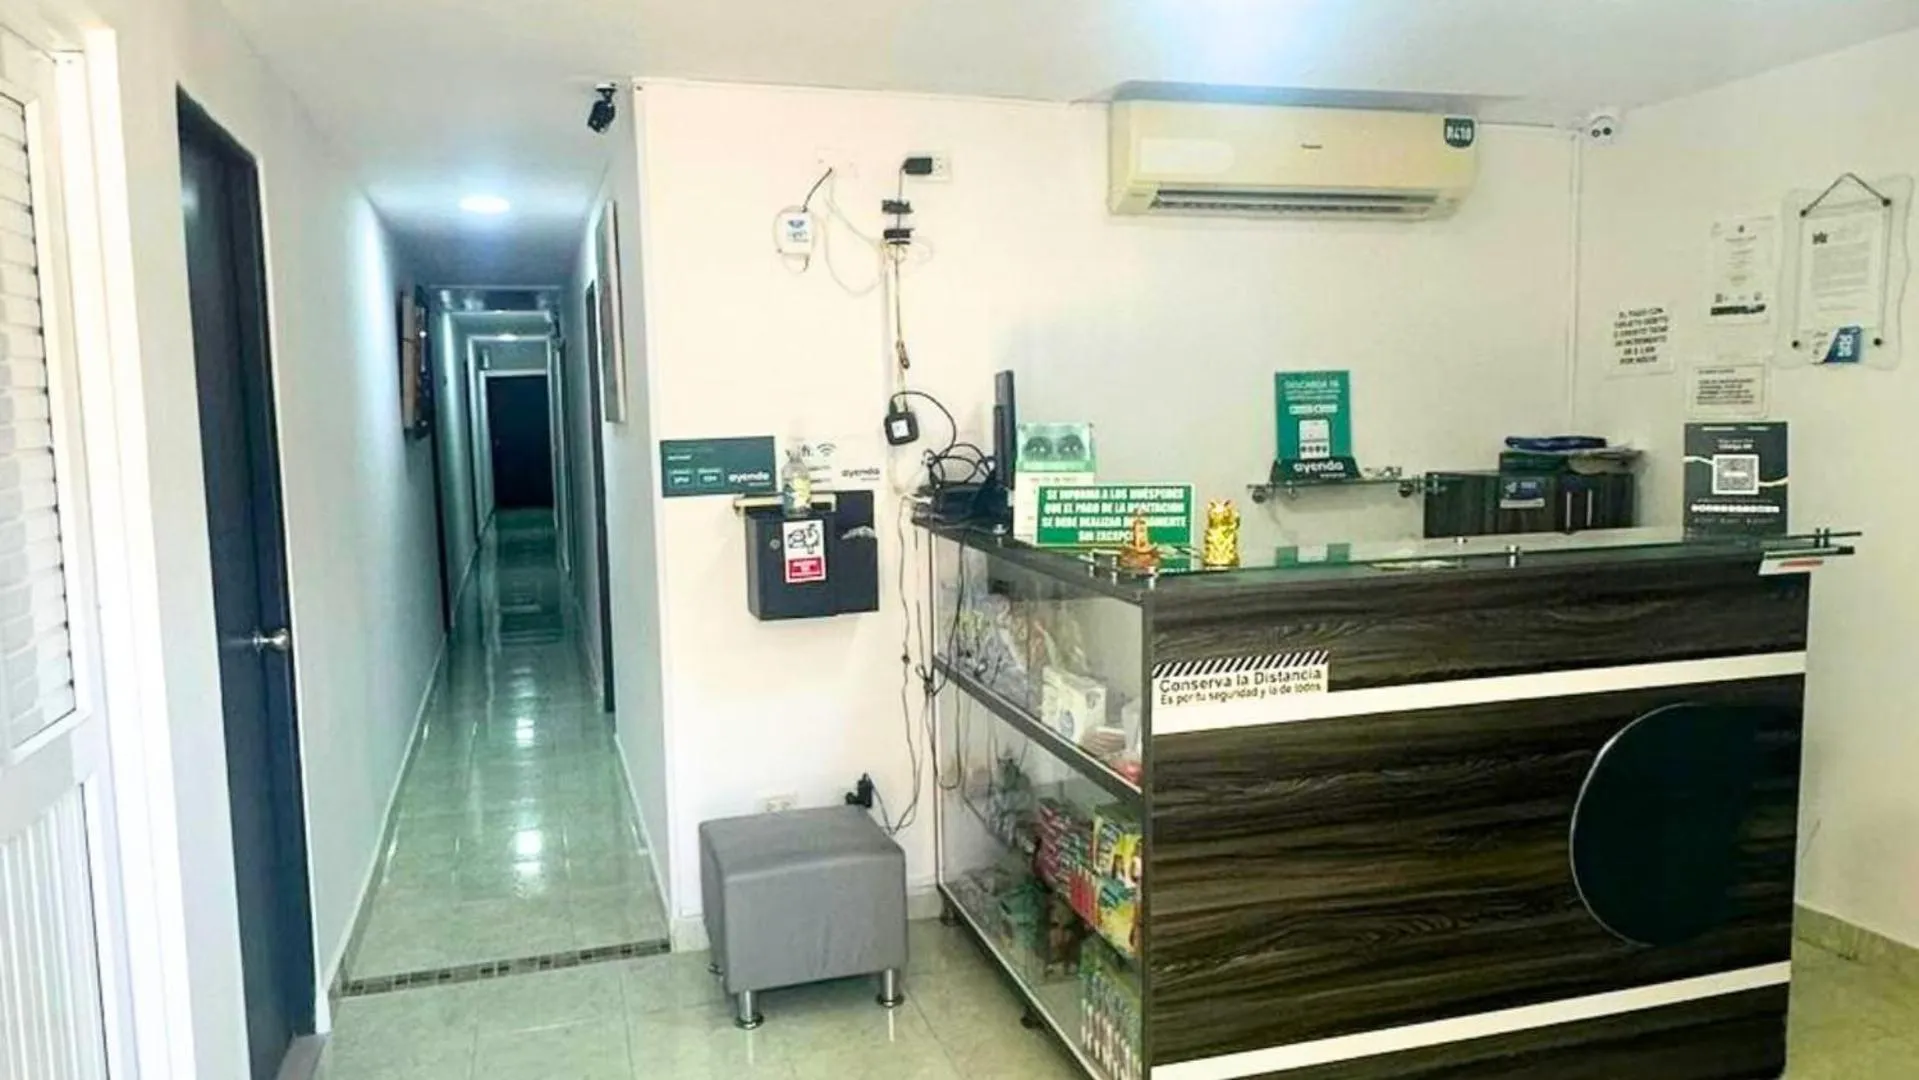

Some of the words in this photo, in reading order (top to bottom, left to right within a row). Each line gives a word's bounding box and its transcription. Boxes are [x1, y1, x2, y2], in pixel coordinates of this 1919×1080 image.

[1293, 461, 1344, 473] ayenda
[1110, 488, 1127, 499] LOS
[1045, 502, 1062, 514] QUE
[1063, 503, 1073, 513] EL
[1075, 502, 1099, 513] PAGO
[1101, 502, 1113, 513] DE
[1114, 502, 1126, 513] LA
[1159, 676, 1232, 693] Conserva
[1236, 674, 1249, 686] la
[1254, 668, 1322, 685] Distancia
[1160, 694, 1174, 705] Es
[1176, 693, 1194, 707] por
[1195, 691, 1206, 702] tu
[1209, 688, 1258, 703] seguridad
[1259, 689, 1266, 699] y
[1268, 684, 1278, 695] la
[1279, 683, 1292, 695] de
